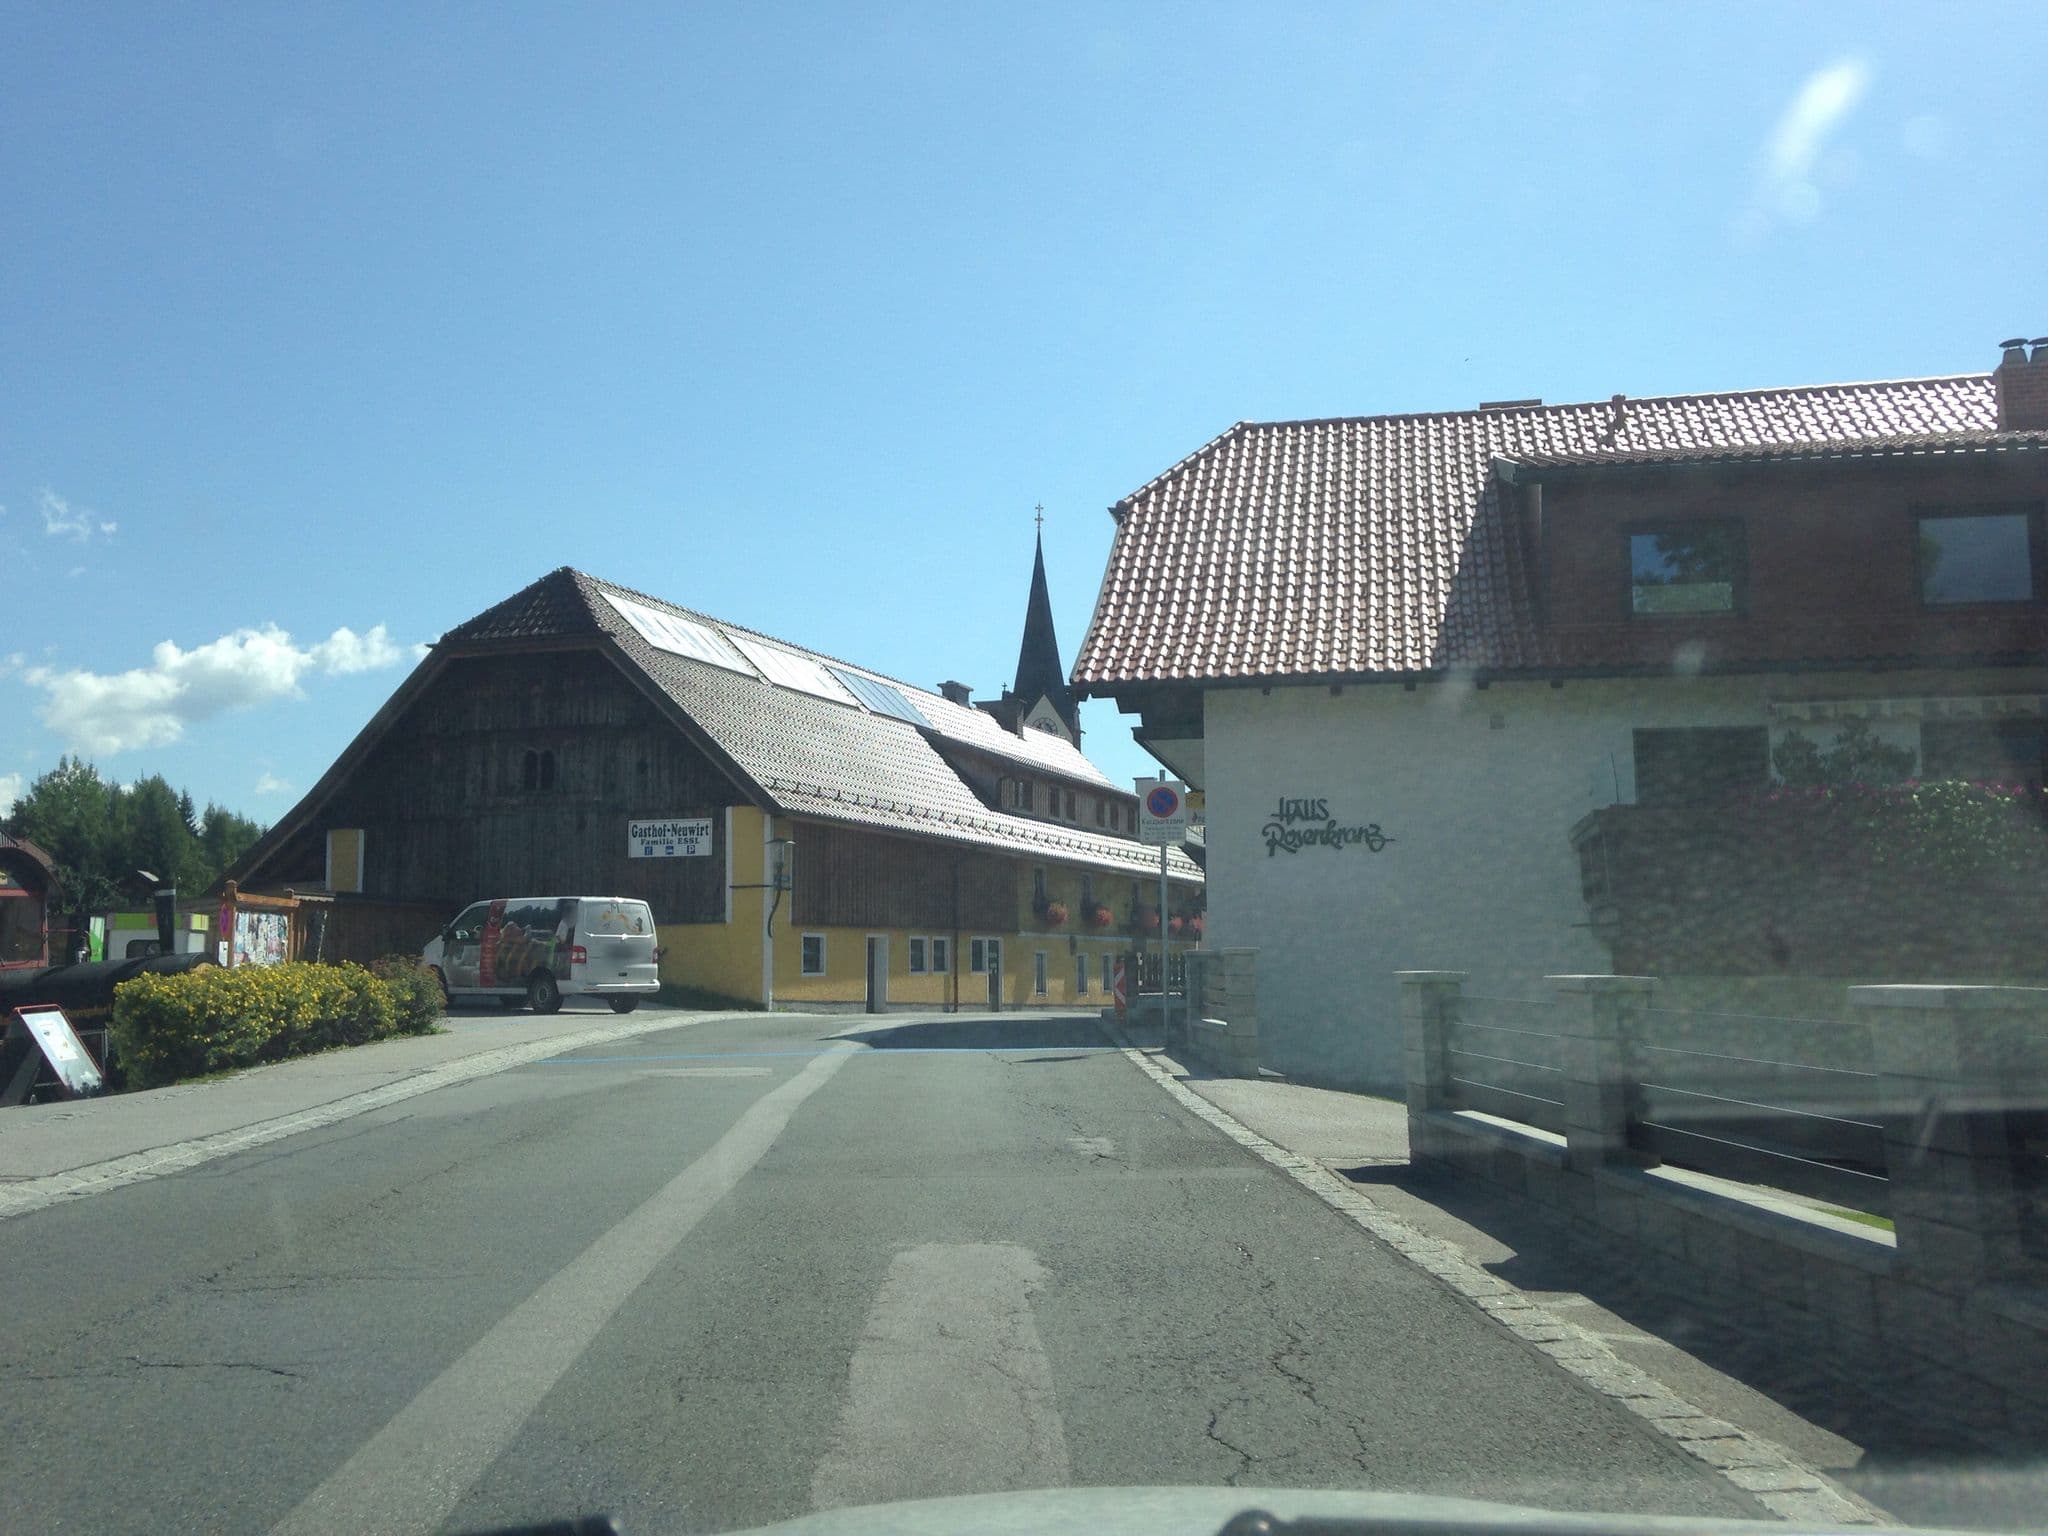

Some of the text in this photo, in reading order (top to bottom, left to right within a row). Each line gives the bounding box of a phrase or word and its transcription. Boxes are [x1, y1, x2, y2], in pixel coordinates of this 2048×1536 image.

[1270, 797, 1330, 826] HAUS
[641, 837, 700, 846] Familie ESSL
[1261, 819, 1396, 857] Rosenkranz
